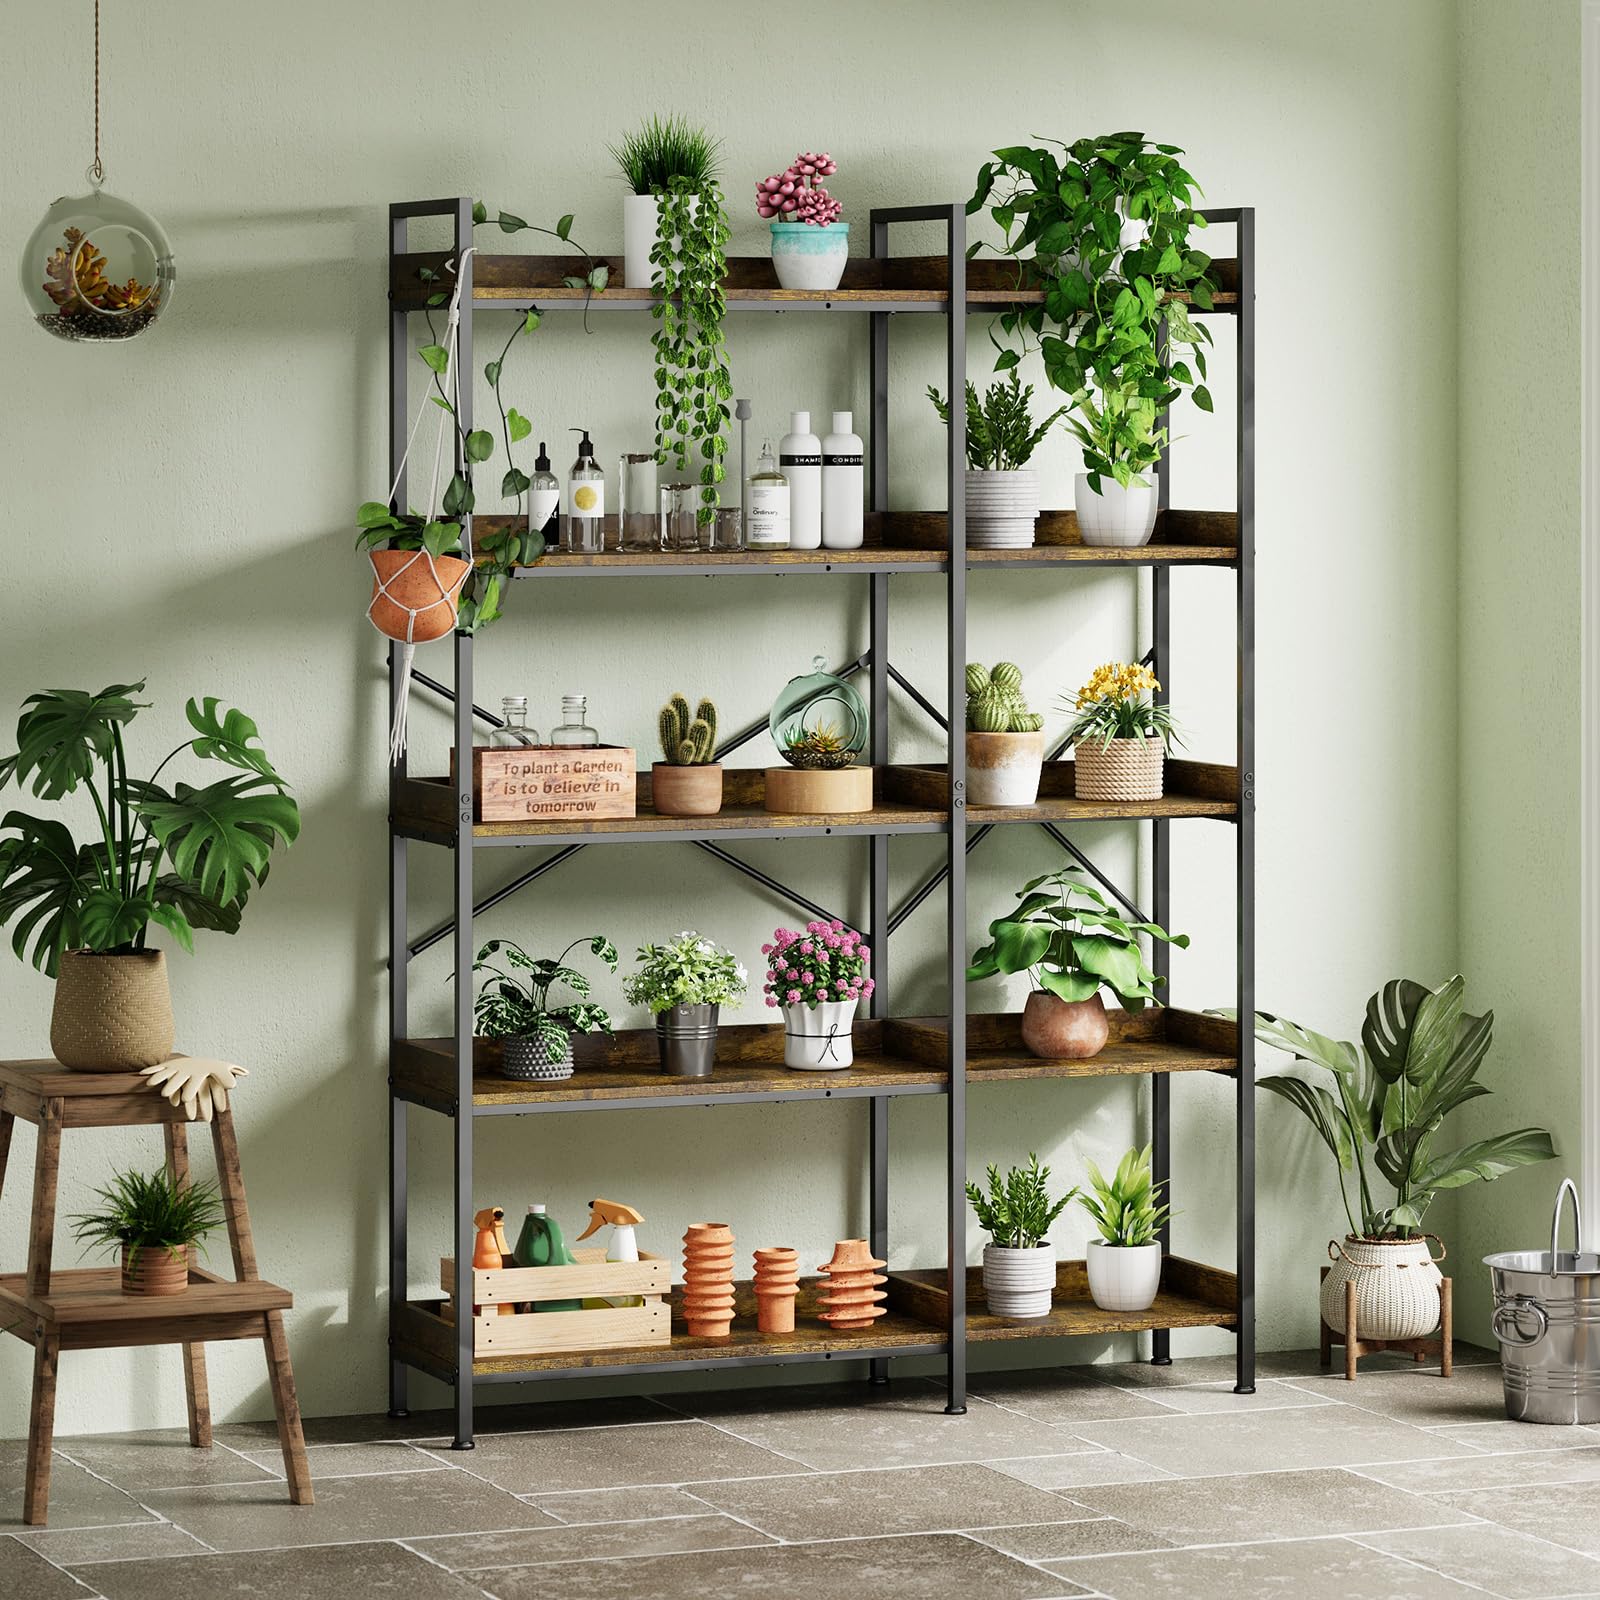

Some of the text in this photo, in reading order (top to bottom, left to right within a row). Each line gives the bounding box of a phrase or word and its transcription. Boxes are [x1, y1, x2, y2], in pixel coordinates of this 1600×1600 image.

[502, 759, 623, 778] To plant a Garden
[503, 779, 621, 795] is to believe in
[526, 801, 597, 814] tomorrow
